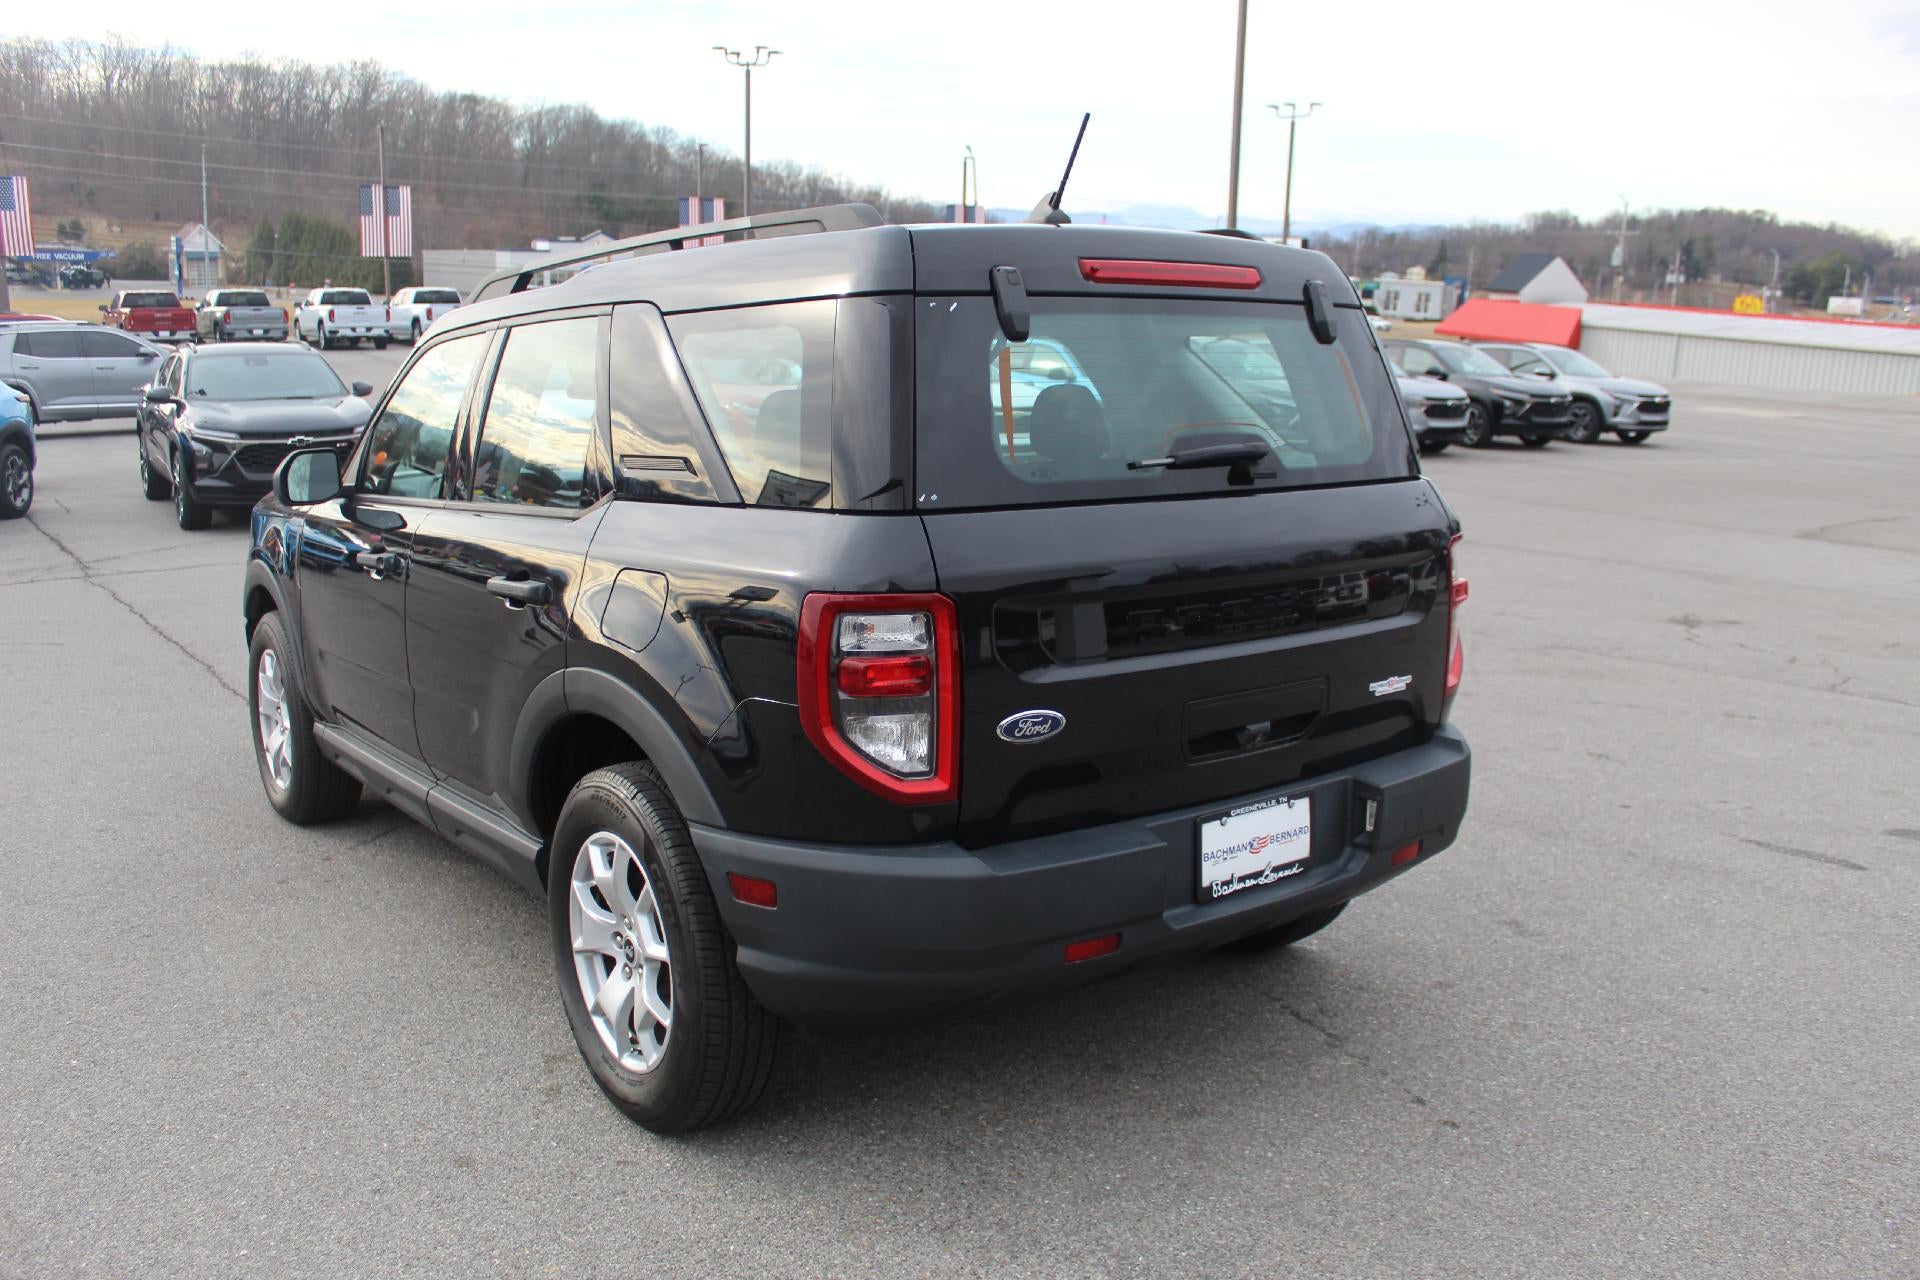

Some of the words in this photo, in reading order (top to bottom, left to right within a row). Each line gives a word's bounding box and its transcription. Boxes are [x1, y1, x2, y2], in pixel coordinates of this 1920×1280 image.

[1014, 717, 1052, 736] Ford
[1230, 799, 1278, 817] GREENEVILLE,
[1279, 796, 1288, 804] TN
[1203, 842, 1248, 863] BACHMAN
[1269, 825, 1310, 845] BERNARD
[1211, 872, 1259, 898] Bachman
